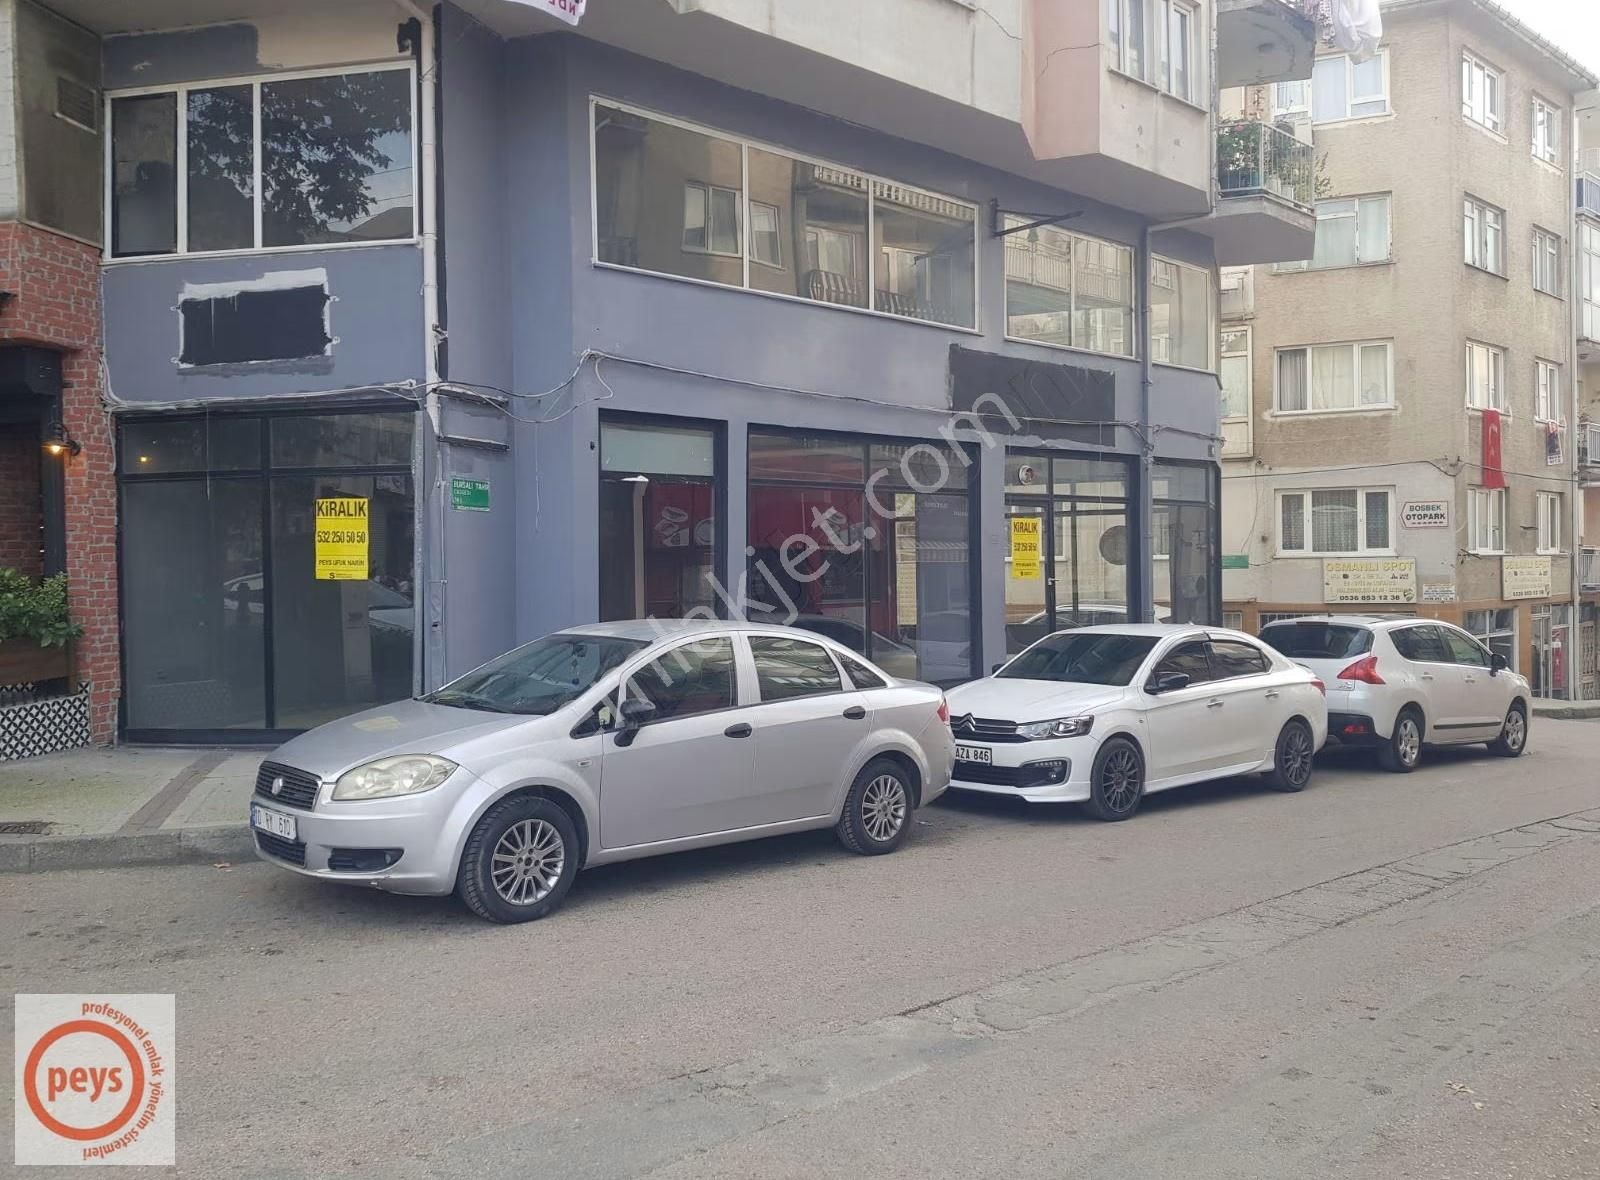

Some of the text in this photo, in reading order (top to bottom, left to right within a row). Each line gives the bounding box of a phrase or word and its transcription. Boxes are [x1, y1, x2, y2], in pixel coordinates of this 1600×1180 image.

[1406, 513, 1446, 521] OTOPARK
[317, 531, 366, 544] 532 250 50 50
[973, 750, 990, 762] 846
